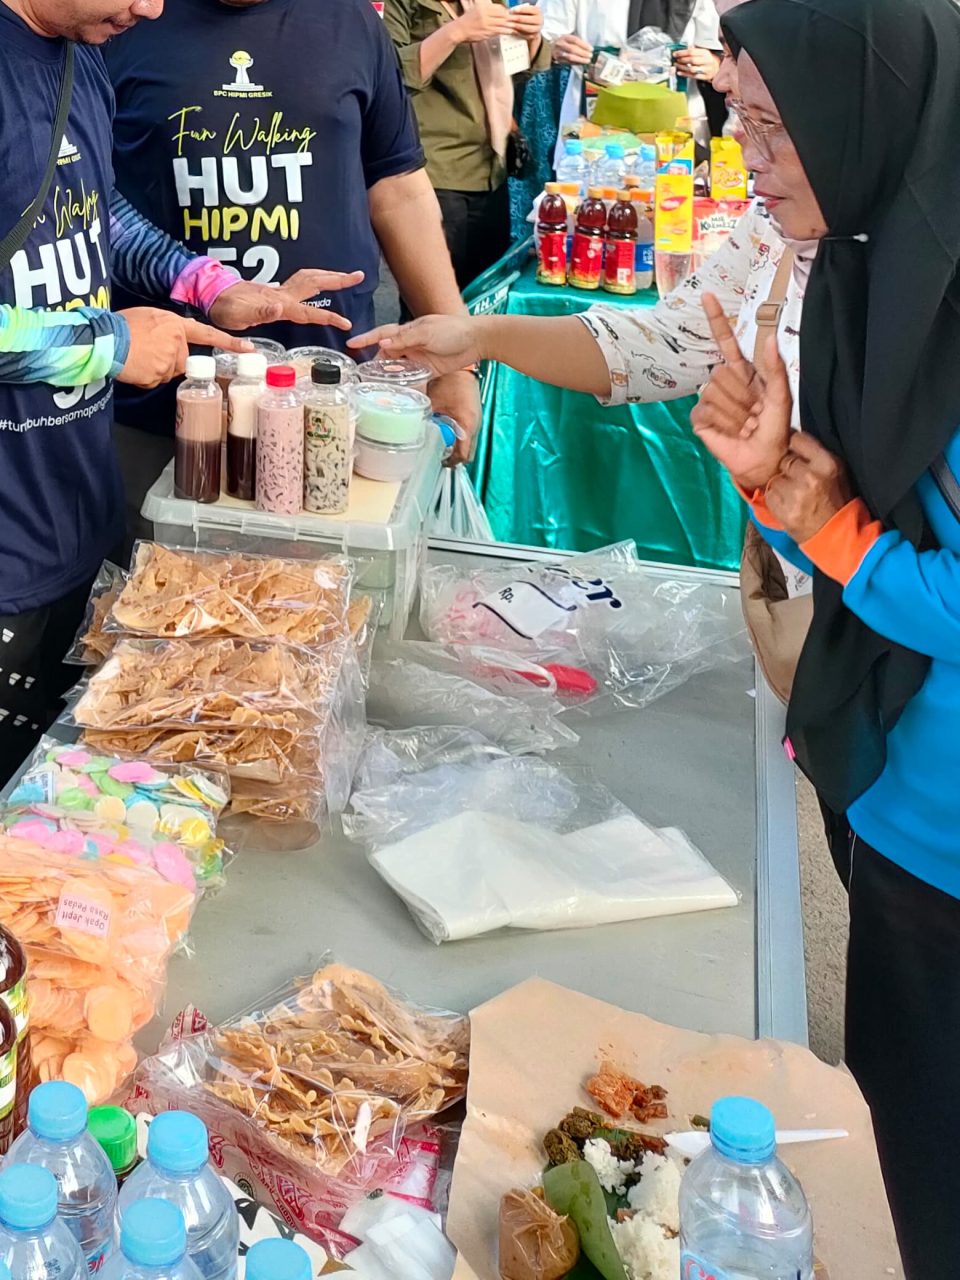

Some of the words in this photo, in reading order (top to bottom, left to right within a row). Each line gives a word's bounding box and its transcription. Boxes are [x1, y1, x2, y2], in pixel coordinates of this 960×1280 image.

[168, 106, 217, 156] Fun
[223, 111, 317, 156] Walking
[172, 151, 314, 207] HUT
[183, 204, 300, 242] HIPMI
[498, 586, 516, 604] Rp.
